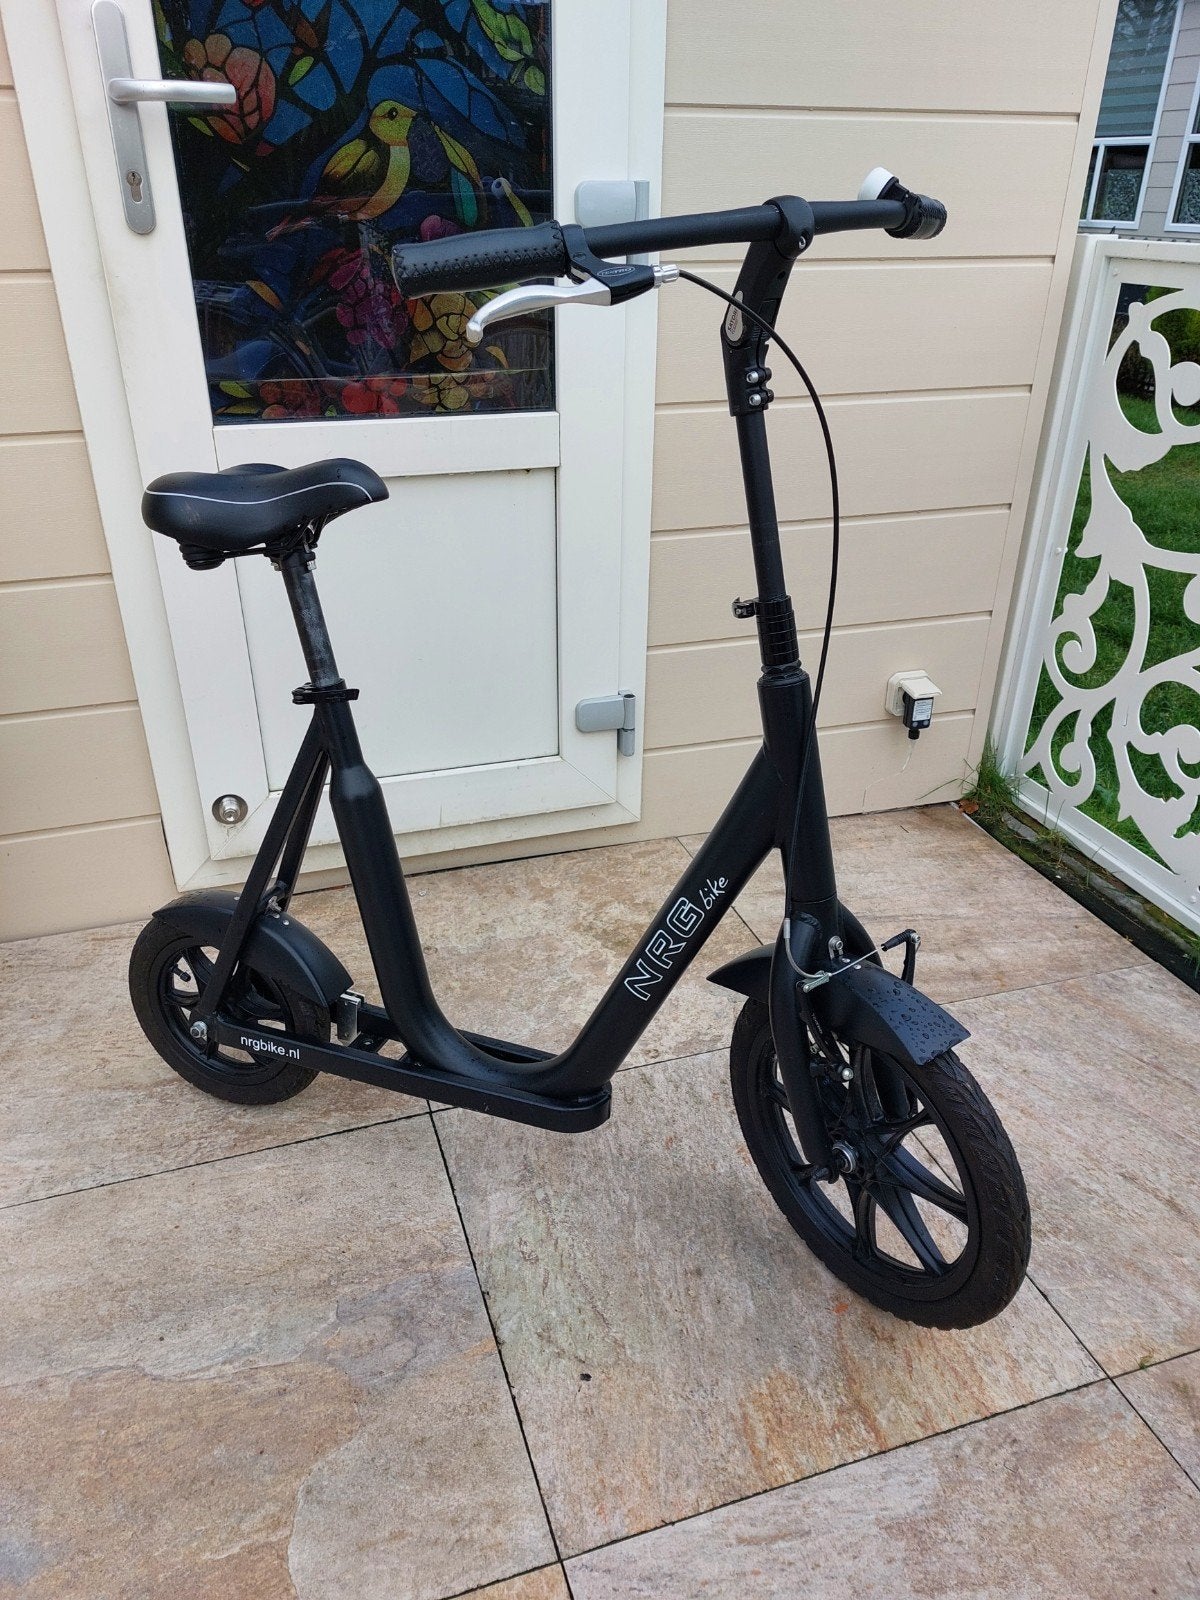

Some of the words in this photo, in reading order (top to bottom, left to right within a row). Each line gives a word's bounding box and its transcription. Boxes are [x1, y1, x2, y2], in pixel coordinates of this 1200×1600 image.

[624, 897, 705, 1001] NRG
[699, 876, 729, 910] bike
[240, 1036, 300, 1060] nrgbike.nl
